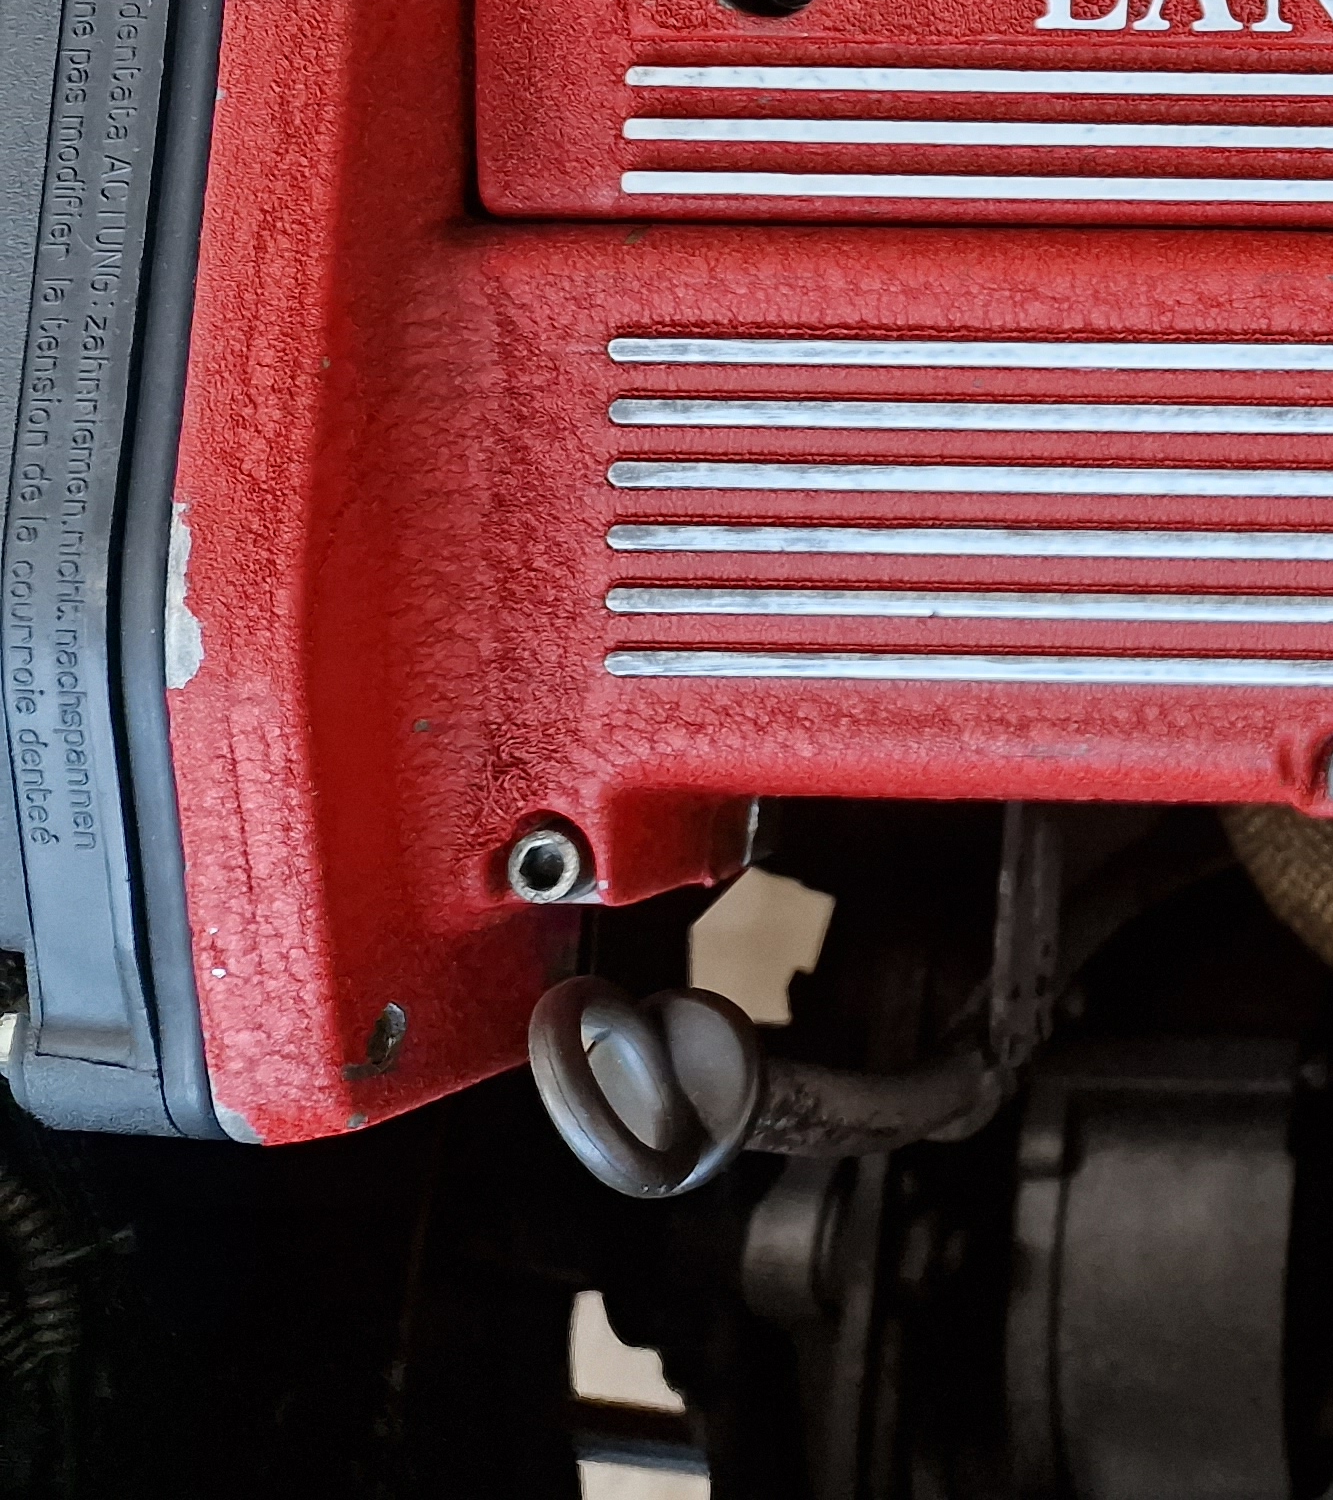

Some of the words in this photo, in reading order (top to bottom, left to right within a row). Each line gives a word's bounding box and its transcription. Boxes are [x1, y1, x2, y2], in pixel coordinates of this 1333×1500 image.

[72, 0, 97, 39] ne
[60, 47, 92, 106] pas
[103, 2, 148, 143] dentata
[43, 114, 87, 261] modifier
[43, 277, 74, 306] la
[25, 316, 70, 448] tension
[20, 462, 53, 502] de
[15, 516, 48, 545] la
[10, 559, 44, 715] courroie
[52, 628, 97, 852] nachspannen
